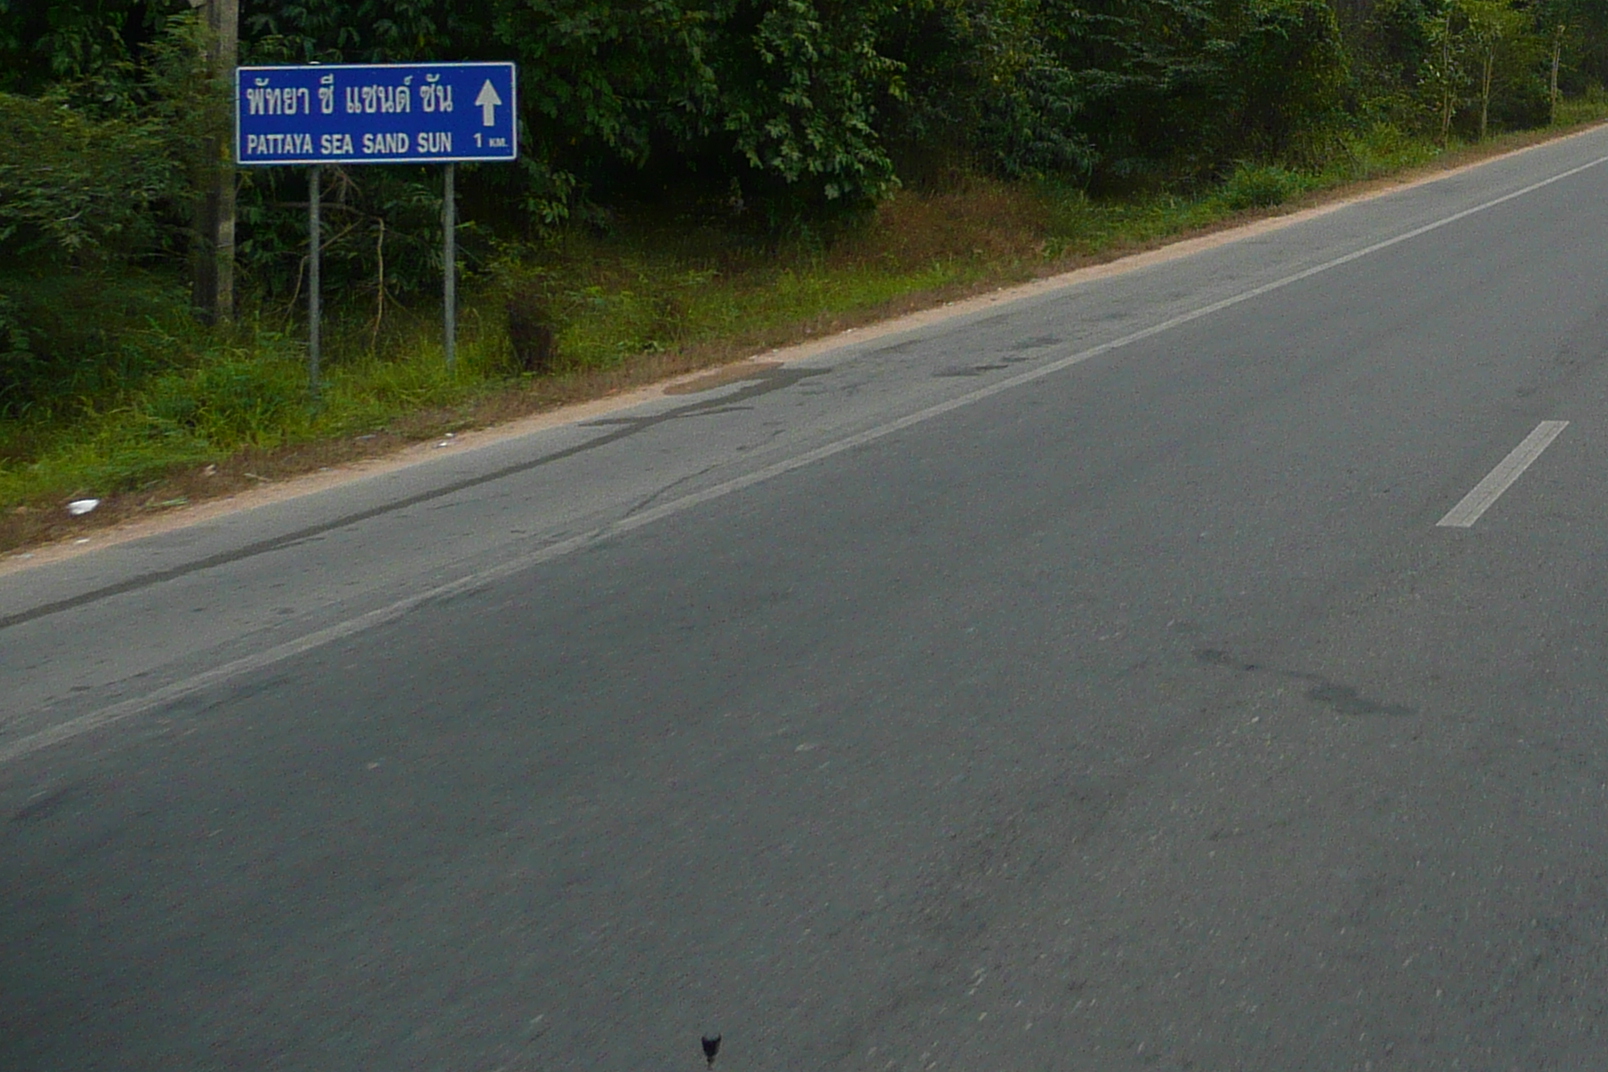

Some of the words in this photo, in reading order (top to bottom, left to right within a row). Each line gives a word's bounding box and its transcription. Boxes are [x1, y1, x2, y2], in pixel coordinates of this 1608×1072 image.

[246, 77, 309, 115] พัทยา
[246, 134, 313, 155] PATTAYA
[320, 133, 353, 155] SEA
[362, 132, 409, 154] SAND
[417, 131, 452, 153] SUN
[473, 133, 483, 148] 1
